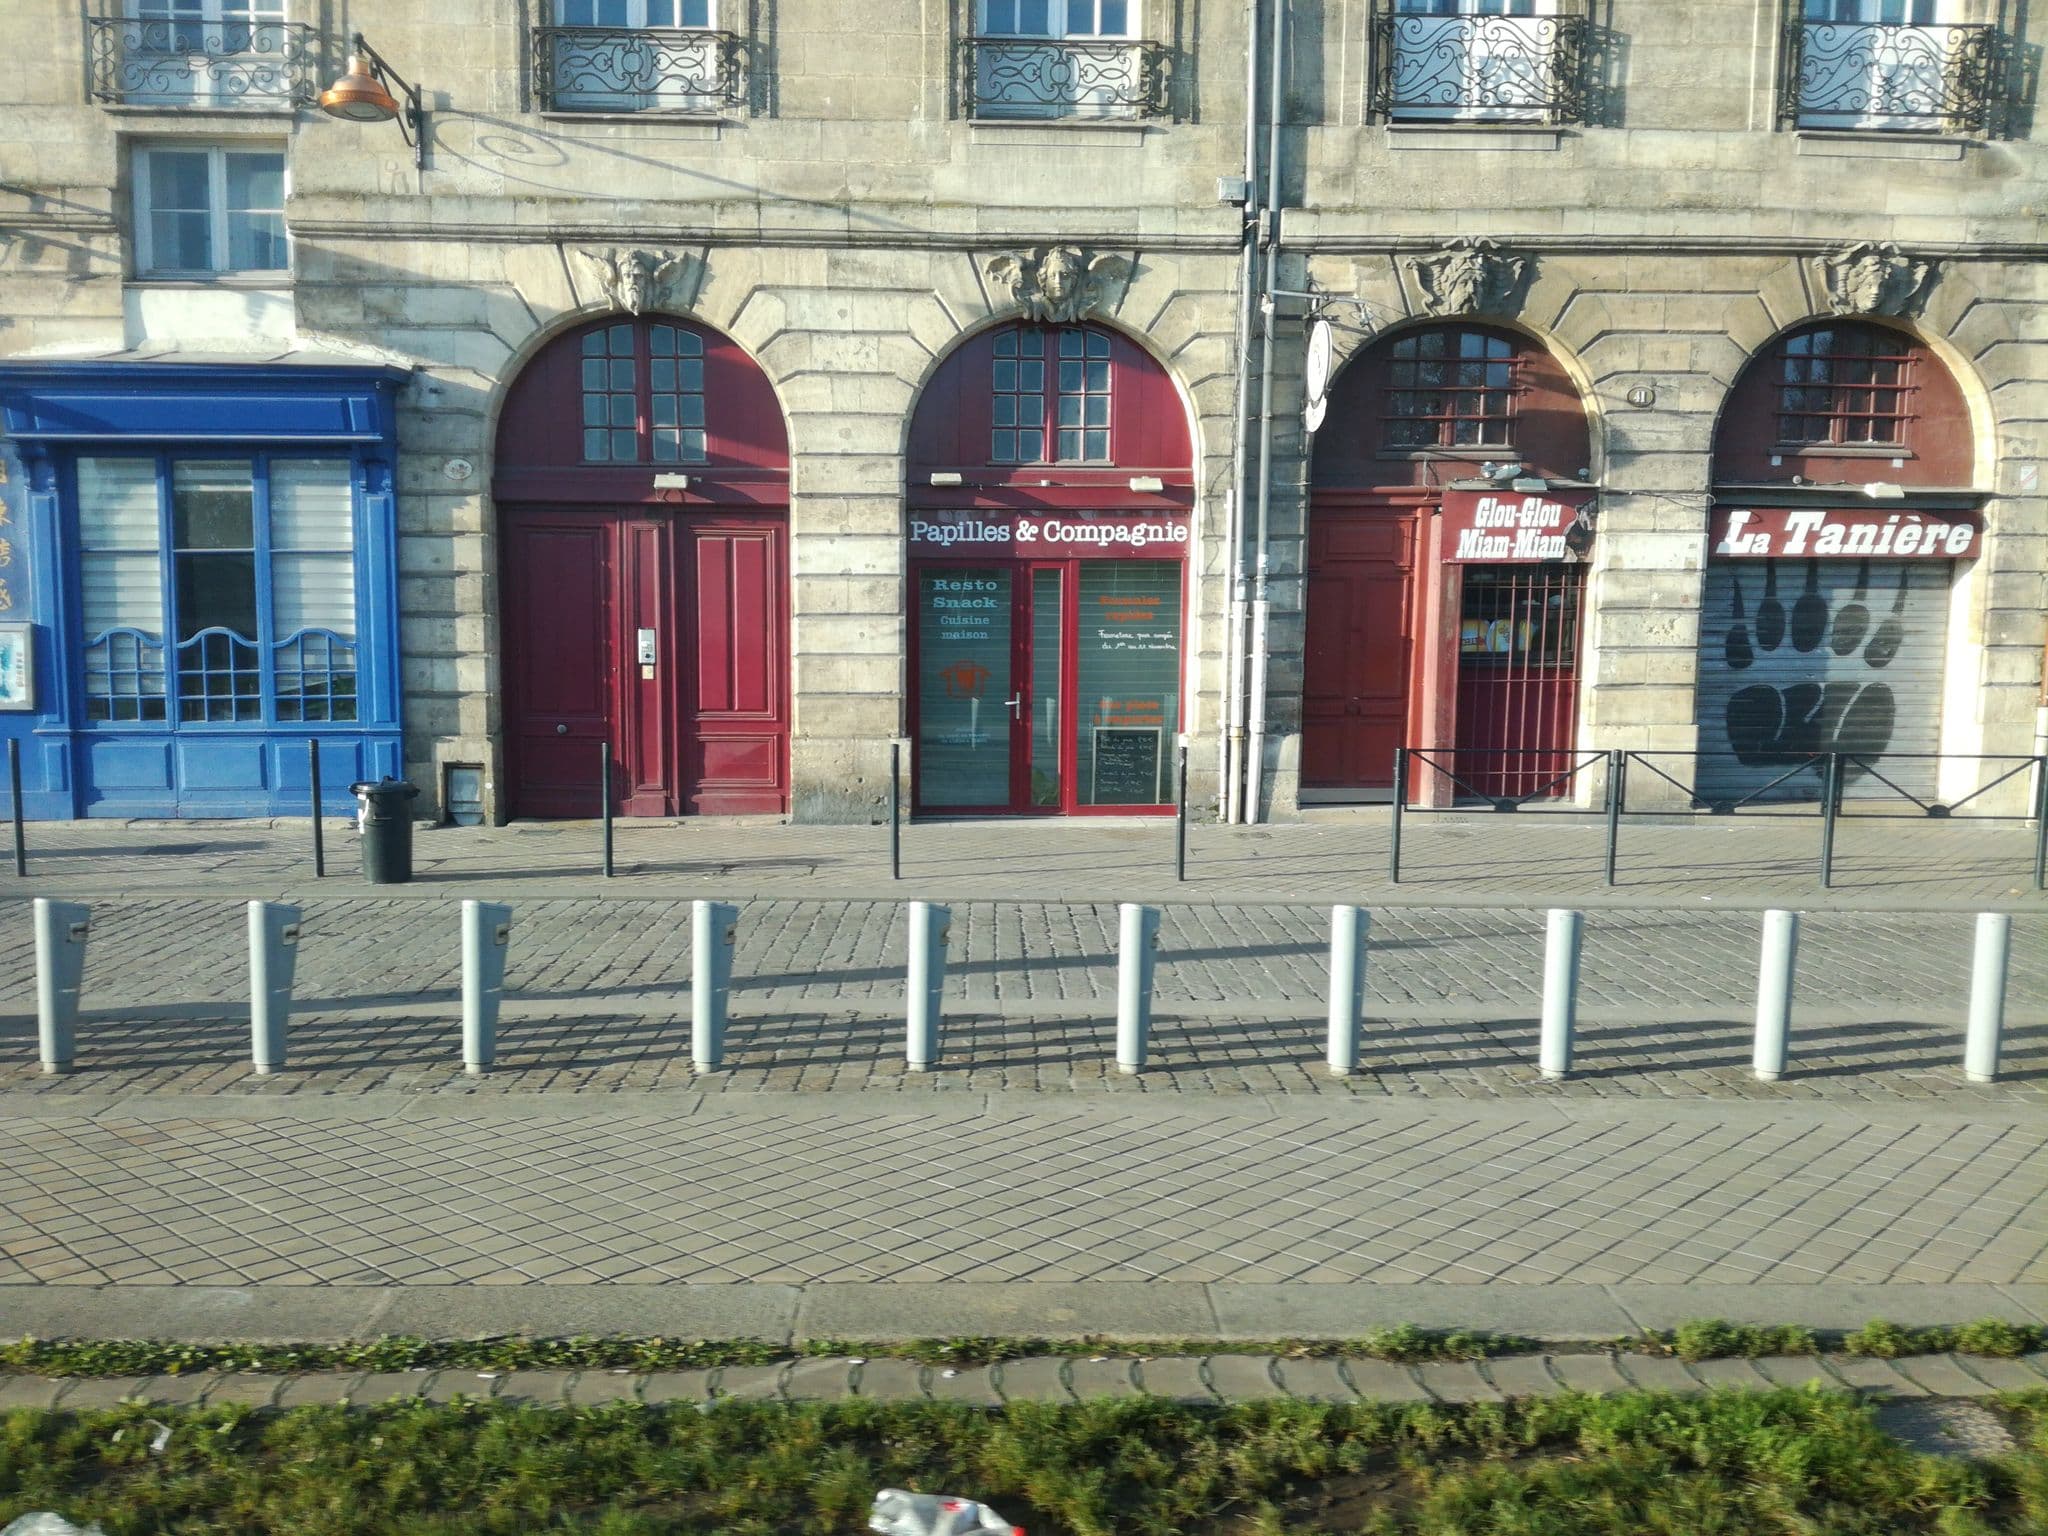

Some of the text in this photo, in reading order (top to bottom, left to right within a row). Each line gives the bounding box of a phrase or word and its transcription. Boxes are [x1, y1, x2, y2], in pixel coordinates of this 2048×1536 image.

[1475, 497, 1562, 528] Glou-Glou
[910, 520, 1188, 546] Papilles & Compagnie
[1716, 510, 1975, 555] La Tanière
[1457, 529, 1567, 559] Miam-Miam
[932, 579, 998, 592] Resto
[932, 597, 998, 609] Snack
[940, 615, 990, 626] Cuisine
[941, 629, 990, 640] maison
